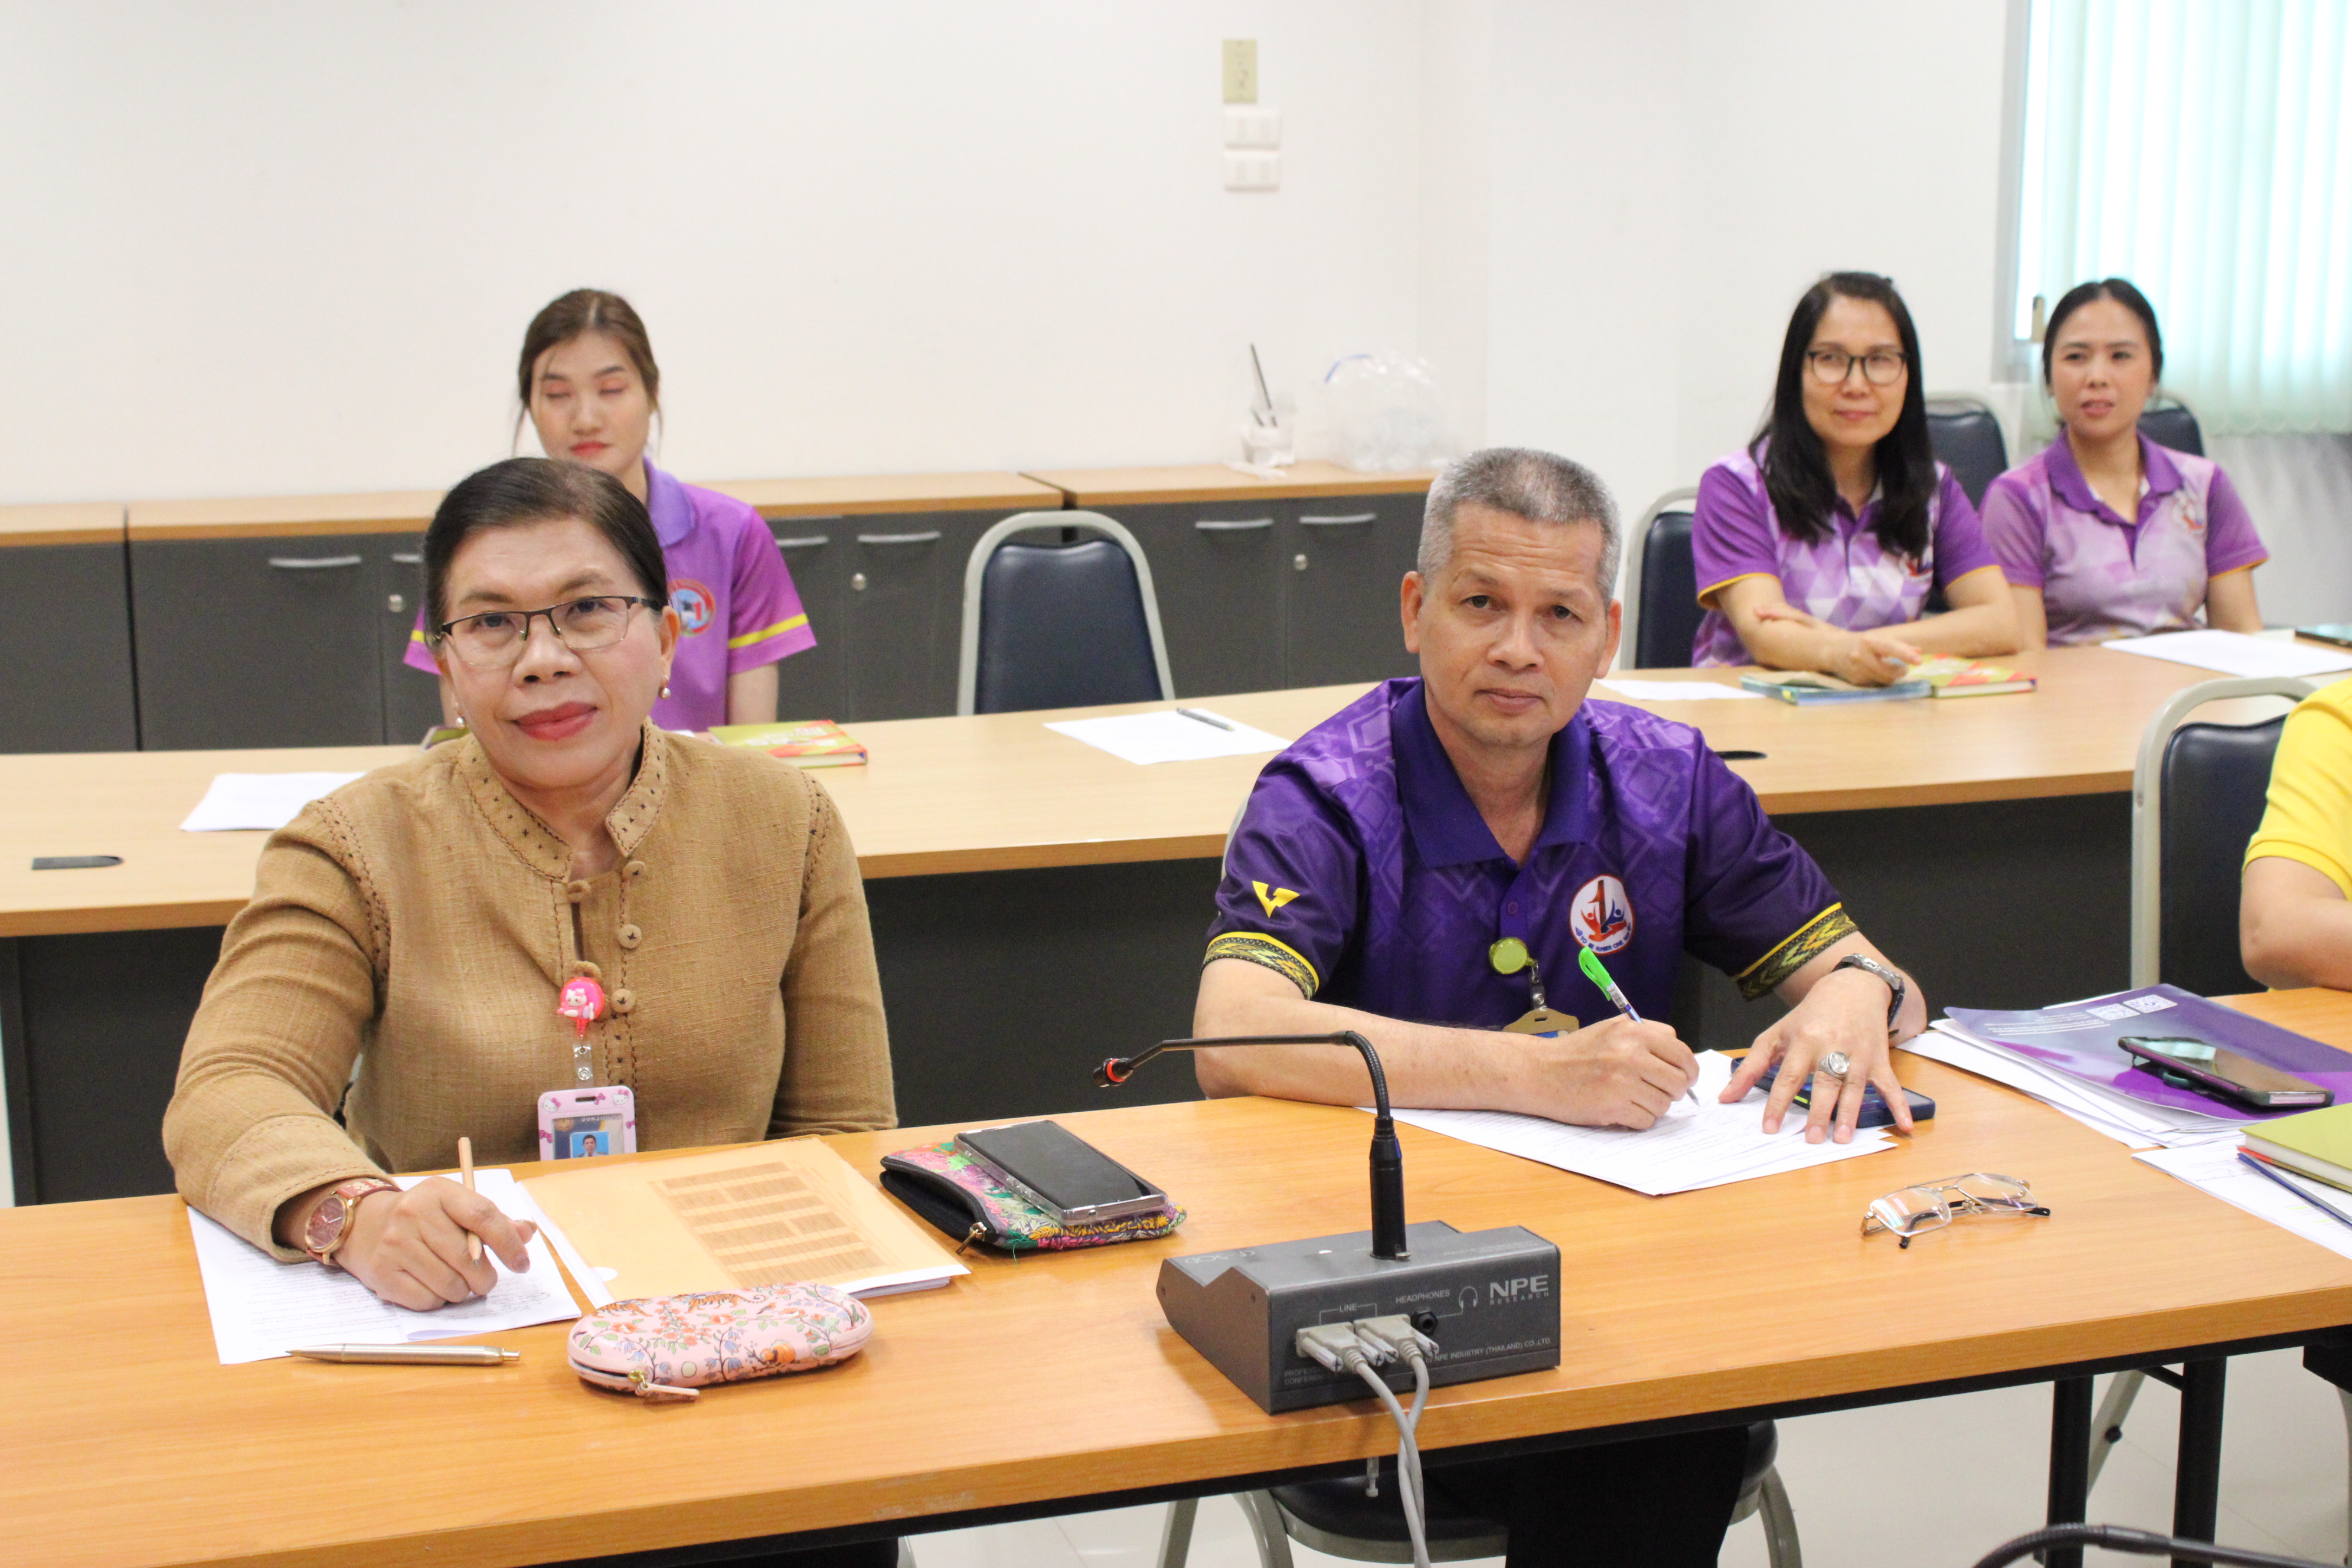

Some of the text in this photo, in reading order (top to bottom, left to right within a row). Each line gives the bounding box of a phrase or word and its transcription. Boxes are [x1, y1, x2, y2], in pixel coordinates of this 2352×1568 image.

[1489, 1275, 1549, 1299] NPE
[1396, 1289, 1451, 1304] HEADPHONES
[1489, 1291, 1550, 1306] RESEARCH
[1339, 1302, 1358, 1313] LINE
[1435, 1353, 1448, 1361] NPE
[1450, 1347, 1485, 1360] INDUSTRY
[1485, 1341, 1523, 1355] (THAILAND)
